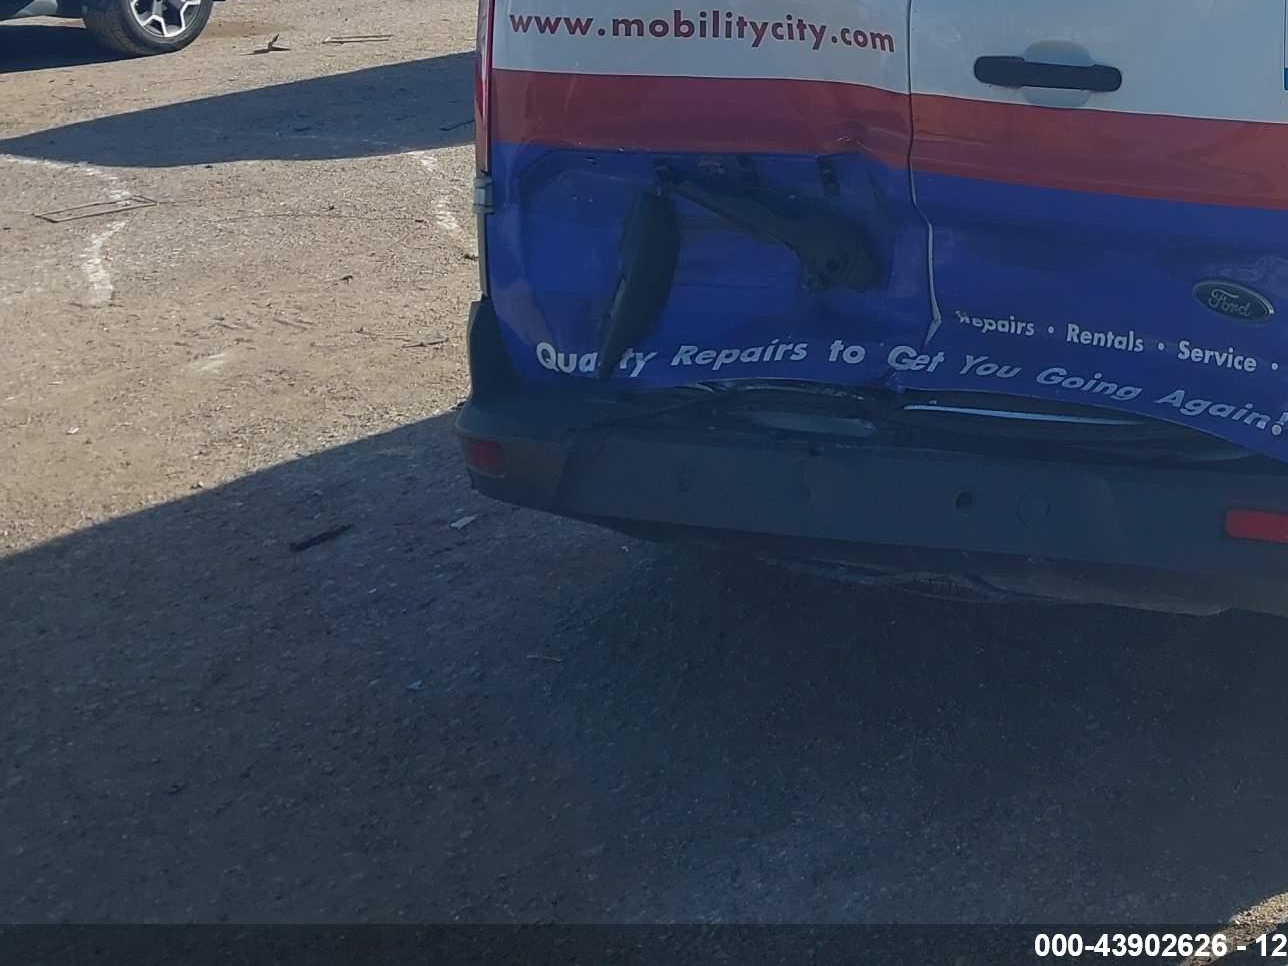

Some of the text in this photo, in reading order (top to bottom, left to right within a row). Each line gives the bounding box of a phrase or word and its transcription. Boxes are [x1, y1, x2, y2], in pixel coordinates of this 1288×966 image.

[510, 9, 895, 53] www.mobilitycity.com
[1208, 288, 1250, 316] Ford
[536, 342, 658, 377] Quaty
[671, 338, 809, 370] Repairs
[828, 339, 866, 364] to
[887, 345, 945, 372] Get
[958, 354, 1022, 379] You
[1036, 367, 1144, 401] Going
[1066, 324, 1144, 353] Rentals
[1177, 340, 1257, 372] Service
